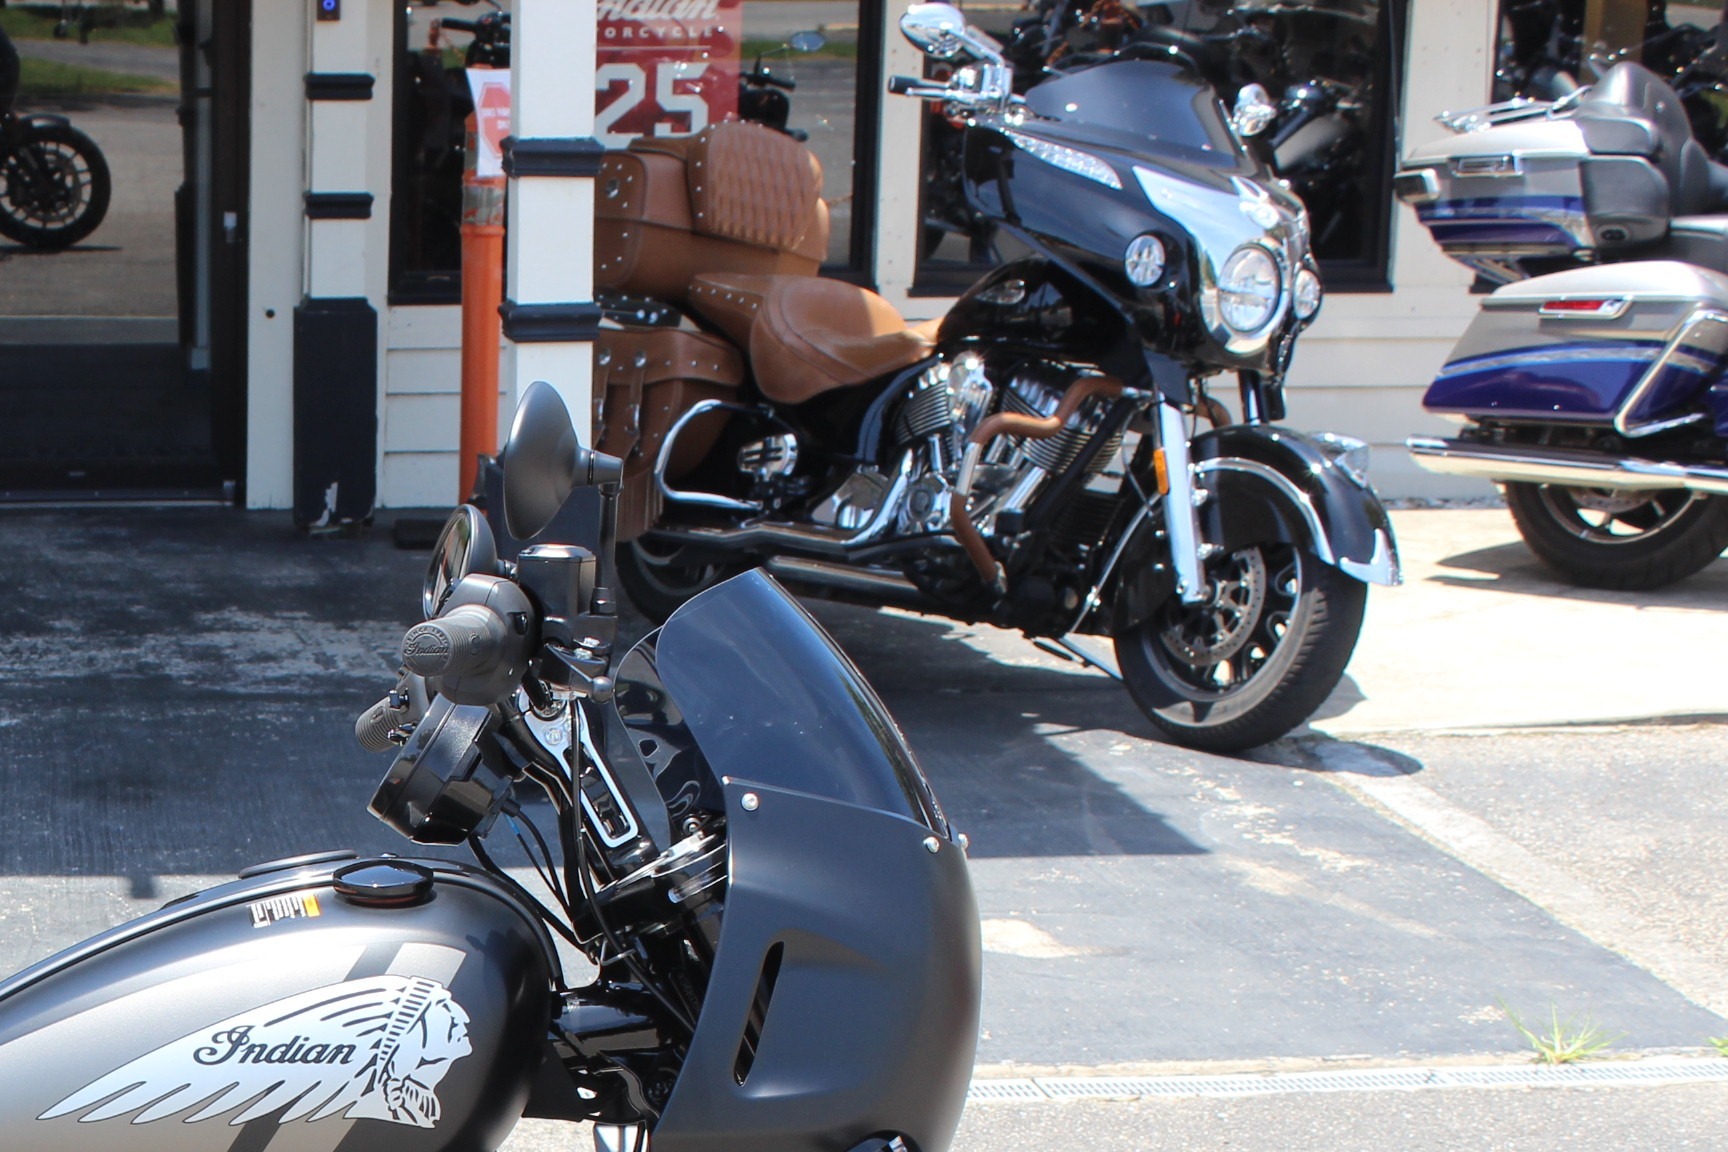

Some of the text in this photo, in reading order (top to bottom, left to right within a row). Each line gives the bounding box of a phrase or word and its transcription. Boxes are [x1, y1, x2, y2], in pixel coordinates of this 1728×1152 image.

[597, 27, 712, 39] ORCYCLE
[404, 641, 449, 657] Indian
[193, 1025, 357, 1065] Indian
